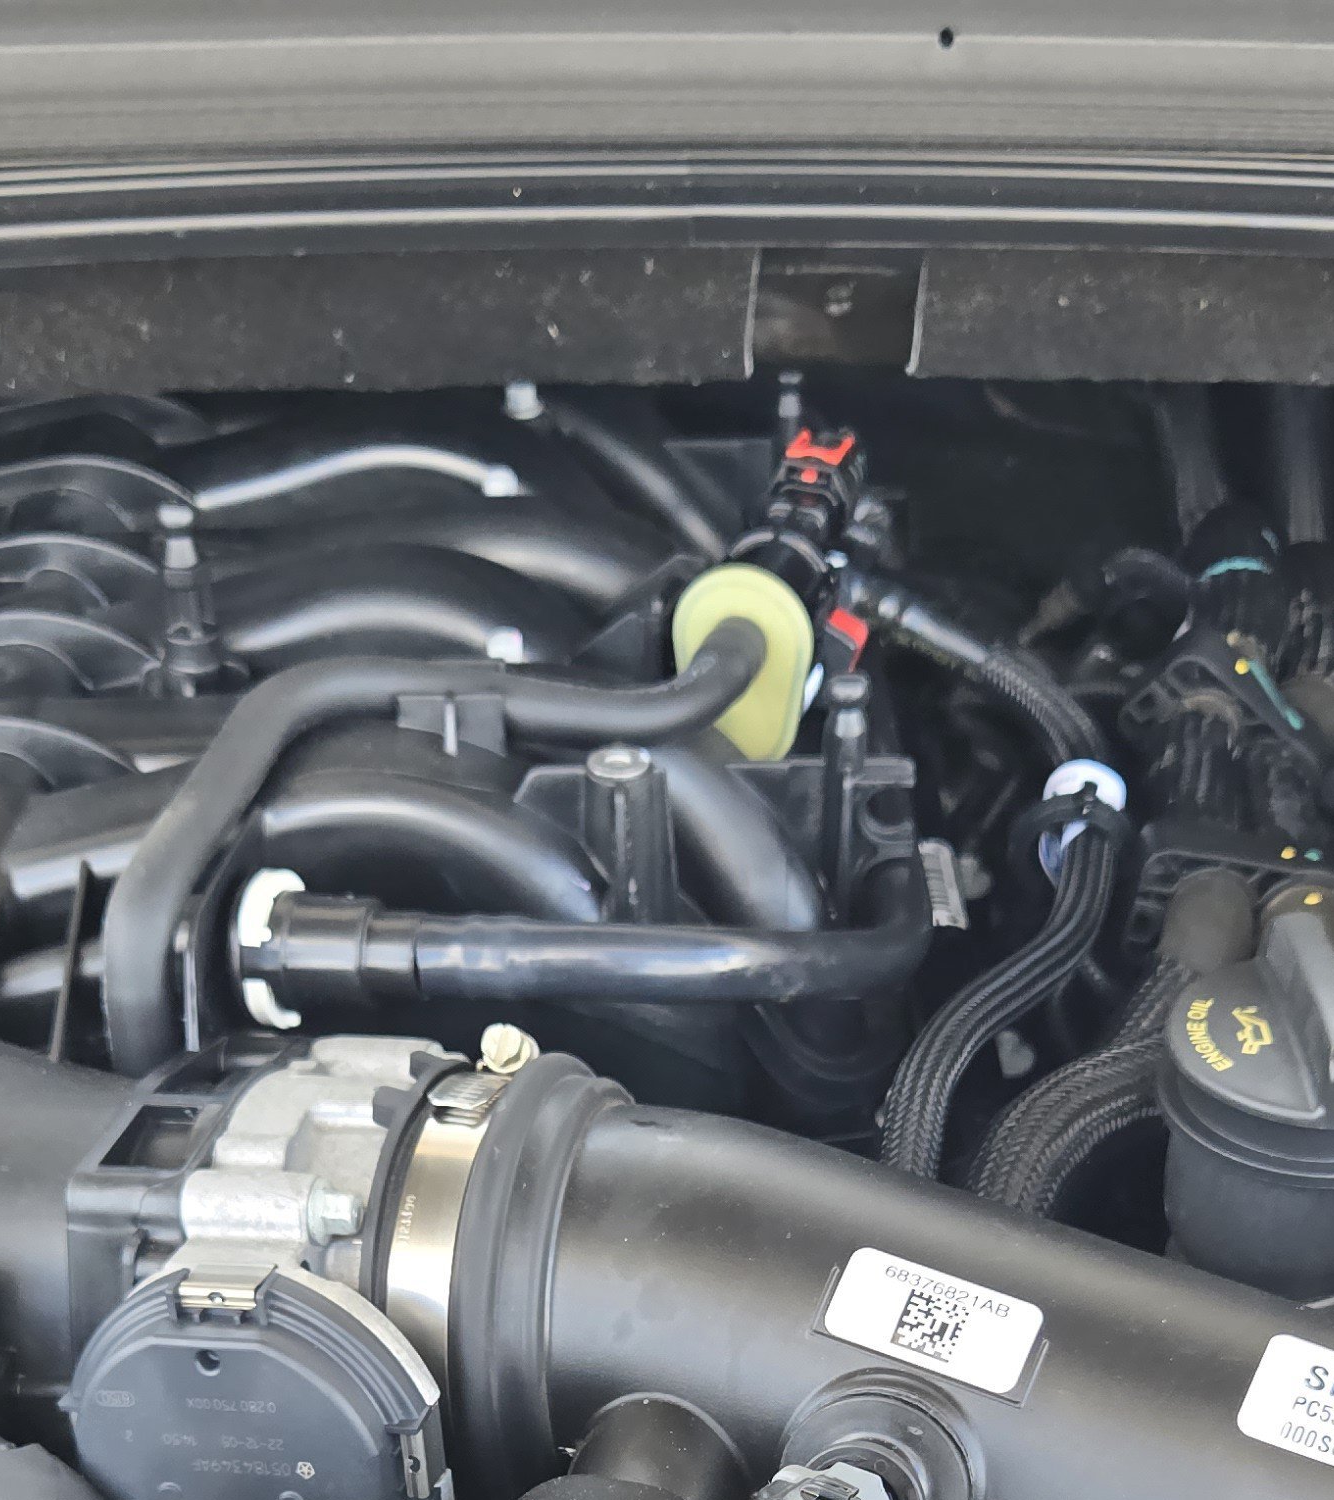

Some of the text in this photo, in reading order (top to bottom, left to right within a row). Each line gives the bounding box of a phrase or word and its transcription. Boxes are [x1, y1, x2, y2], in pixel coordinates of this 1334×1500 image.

[1186, 998, 1234, 1072] ENGINE OIL
[884, 1265, 1011, 1318] 68376821AB
